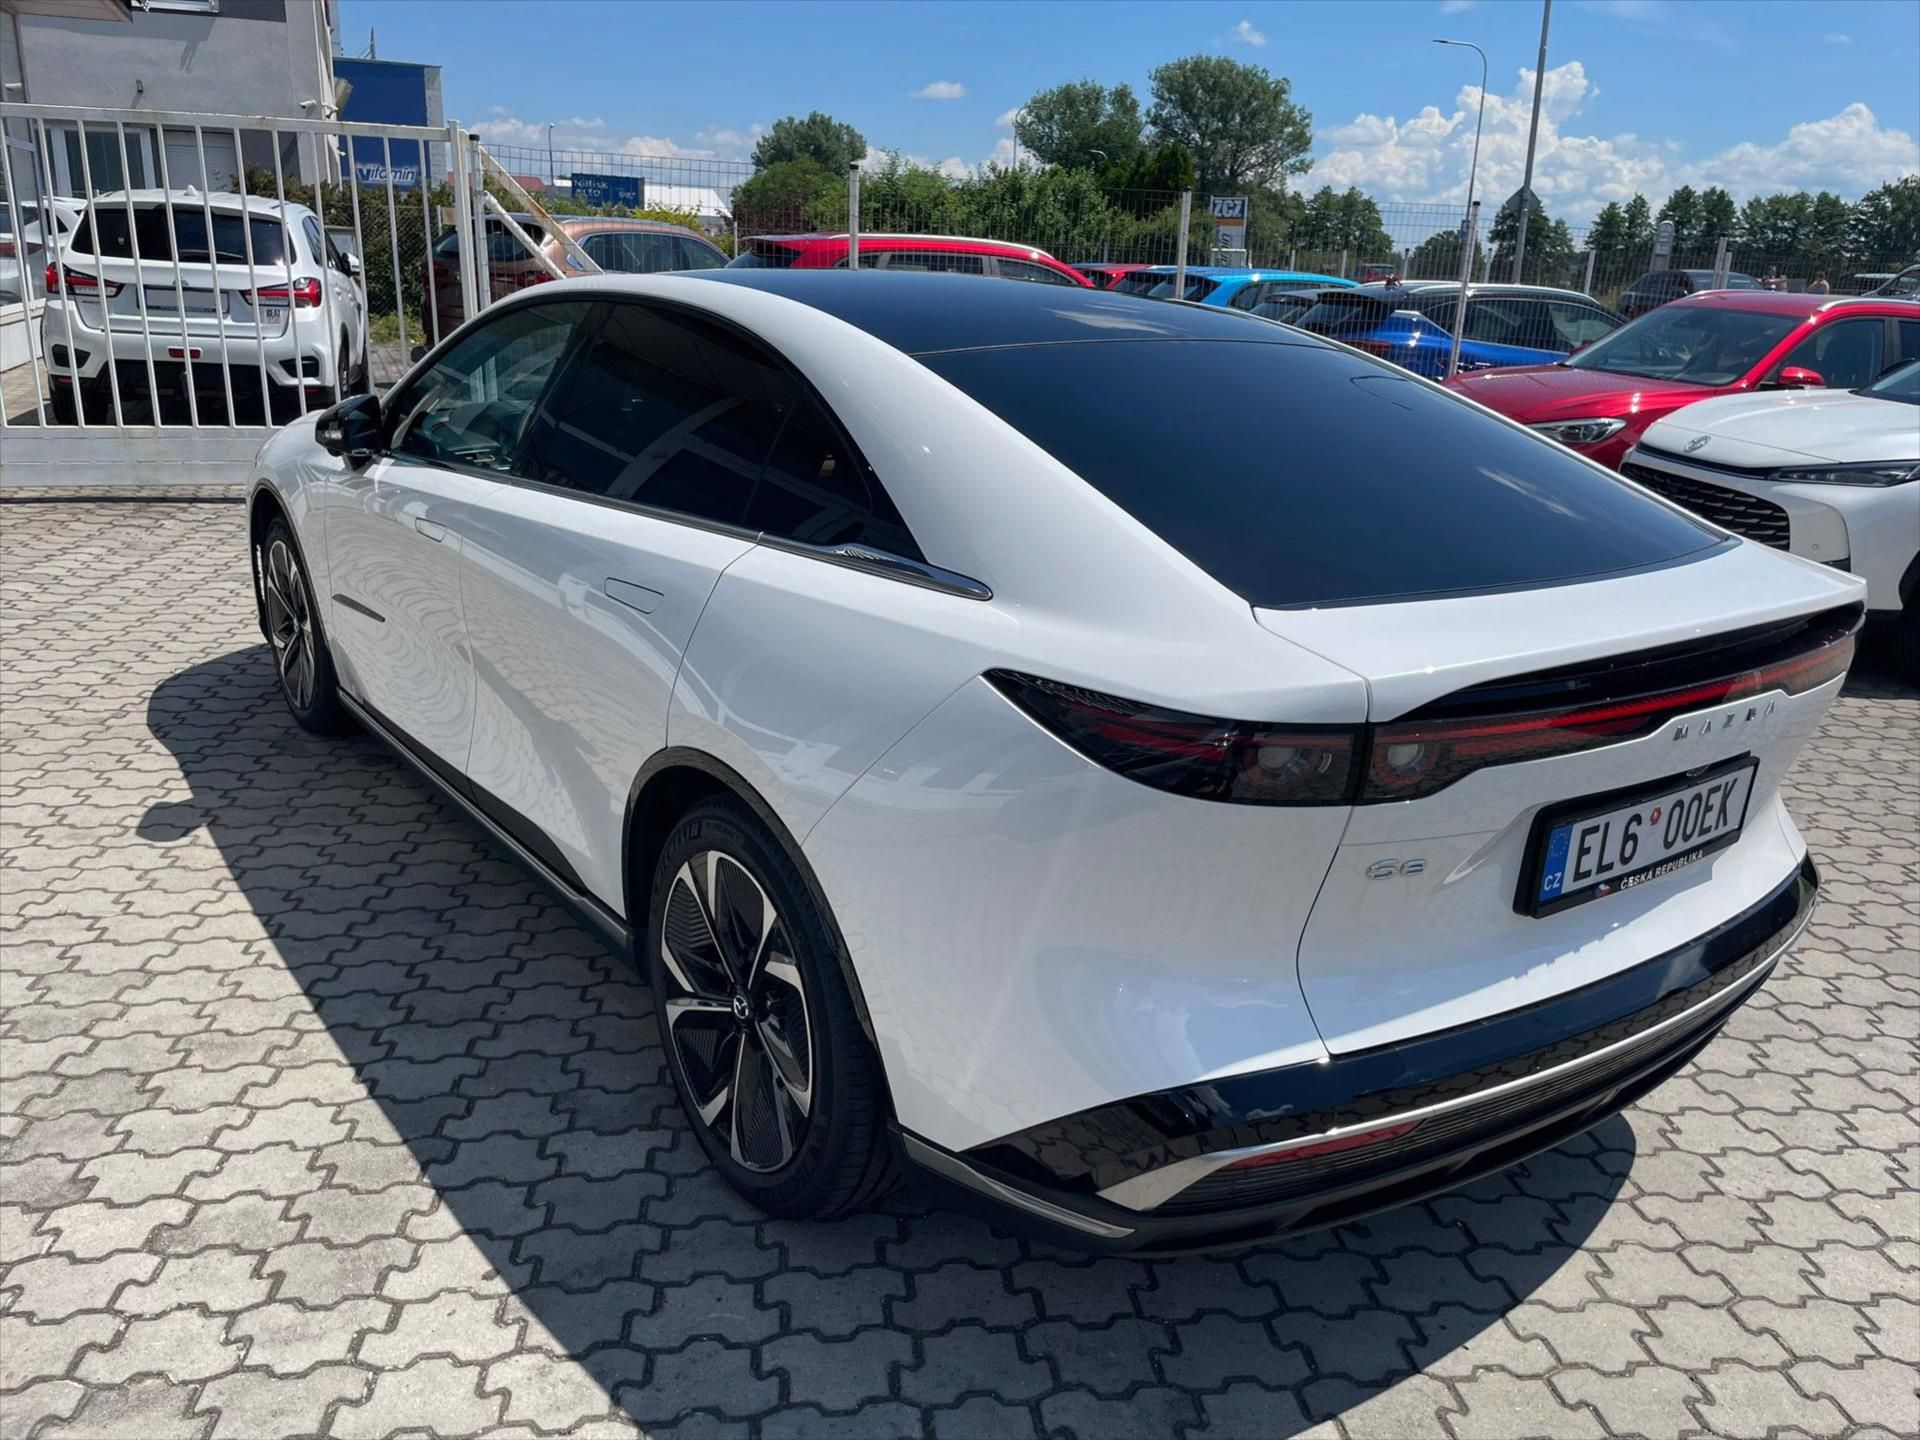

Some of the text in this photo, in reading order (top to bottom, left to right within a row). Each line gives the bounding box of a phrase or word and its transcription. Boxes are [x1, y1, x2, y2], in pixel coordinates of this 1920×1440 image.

[1213, 200, 1243, 218] ZCZ
[1573, 813, 1642, 882] EL6
[1544, 871, 1562, 891] CZ
[1620, 849, 1703, 890] ČESKÁ REPUBLIKA
